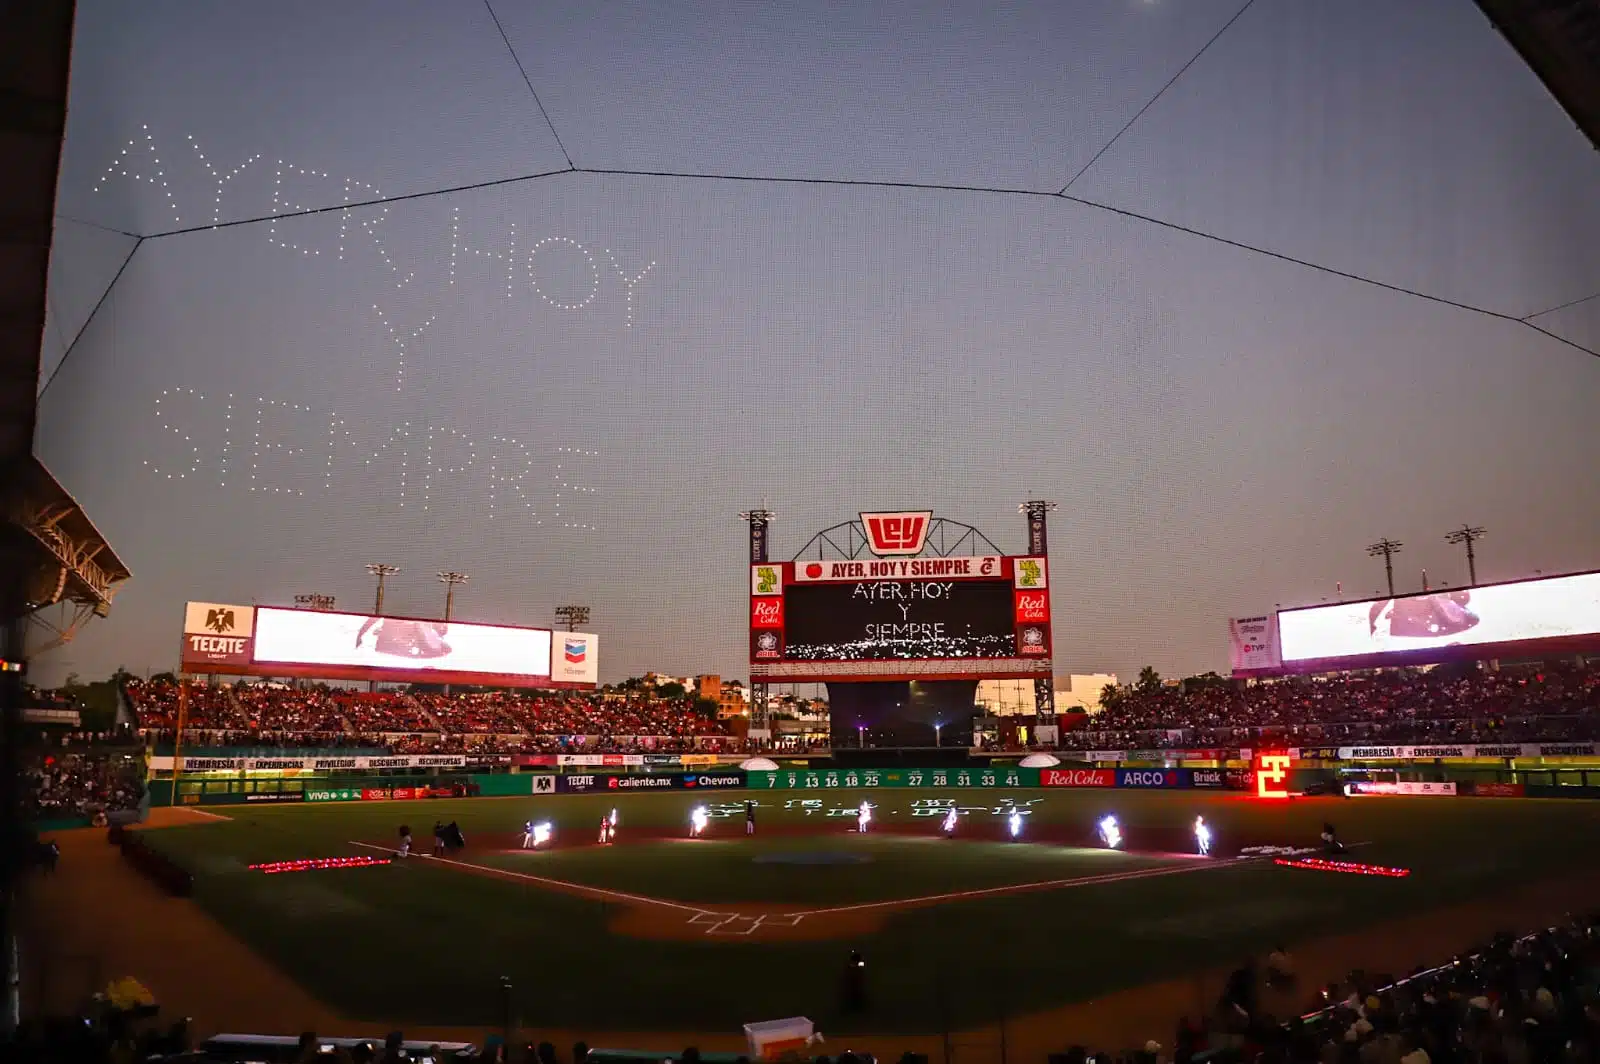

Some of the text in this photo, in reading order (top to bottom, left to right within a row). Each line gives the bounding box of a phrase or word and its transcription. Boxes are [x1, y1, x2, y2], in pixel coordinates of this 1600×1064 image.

[450, 206, 656, 328] HOY
[373, 304, 436, 391] Y
[143, 386, 599, 531] SIEMPRE
[831, 560, 970, 578] AYER, HOY Y SIEMPRE
[911, 582, 953, 599] HOY
[1018, 595, 1045, 610] Red
[754, 601, 780, 616] Red
[898, 603, 911, 621] Y
[1024, 608, 1043, 618] Cola
[760, 614, 778, 624] Cola
[865, 622, 945, 642] SIEMPRE
[190, 635, 248, 654] TECATE
[1414, 747, 1463, 757] EXPERIENCIAS
[256, 759, 304, 769] EXPERIENCIAS
[316, 759, 356, 768] PRIVILEGIOS
[369, 757, 410, 767] DESCUENTOS
[418, 756, 462, 766] RECOMPENSAS
[567, 776, 595, 786] TECATE
[618, 777, 672, 787] caliente.mx
[698, 776, 740, 786] Chevron
[805, 777, 819, 788] 13
[825, 777, 839, 787] 16
[844, 777, 859, 787] 18
[864, 776, 879, 786] 25
[908, 776, 923, 786] 27
[933, 776, 947, 786] 28
[957, 776, 971, 786] 31
[981, 776, 995, 786] 33
[1005, 776, 1020, 786] 41
[1048, 770, 1104, 785] Red Cola
[1124, 772, 1164, 785] ARCO
[768, 778, 776, 788] 7
[788, 778, 796, 788] 9
